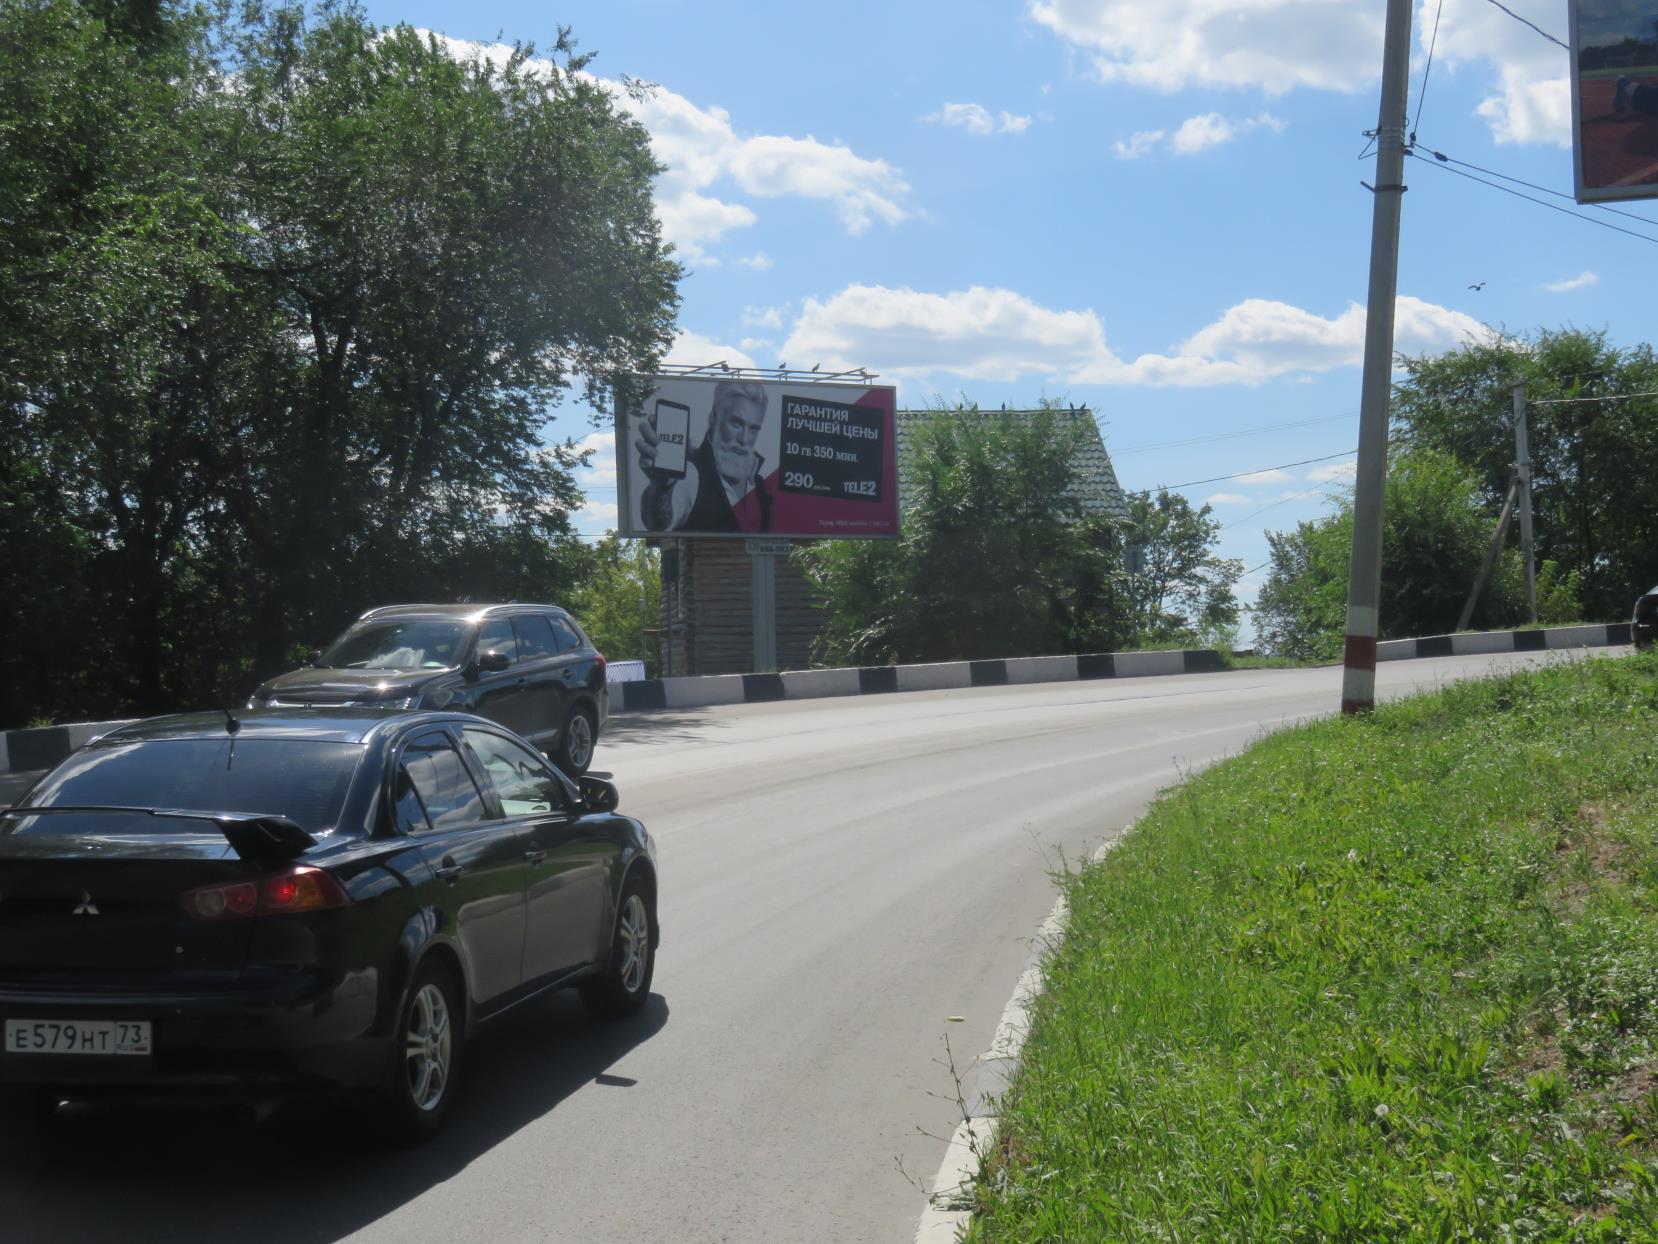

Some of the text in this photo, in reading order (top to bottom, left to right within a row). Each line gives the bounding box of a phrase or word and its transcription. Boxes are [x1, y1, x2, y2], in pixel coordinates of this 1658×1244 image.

[787, 402, 849, 422] ГАРАНТИЯ
[787, 417, 878, 440] ЛУЧШЕЙ ЦЕНЫ
[660, 433, 684, 445] TELE2
[786, 442, 799, 455] 10
[813, 445, 834, 459] 350
[784, 471, 813, 489] 290
[843, 480, 877, 496] TELE2
